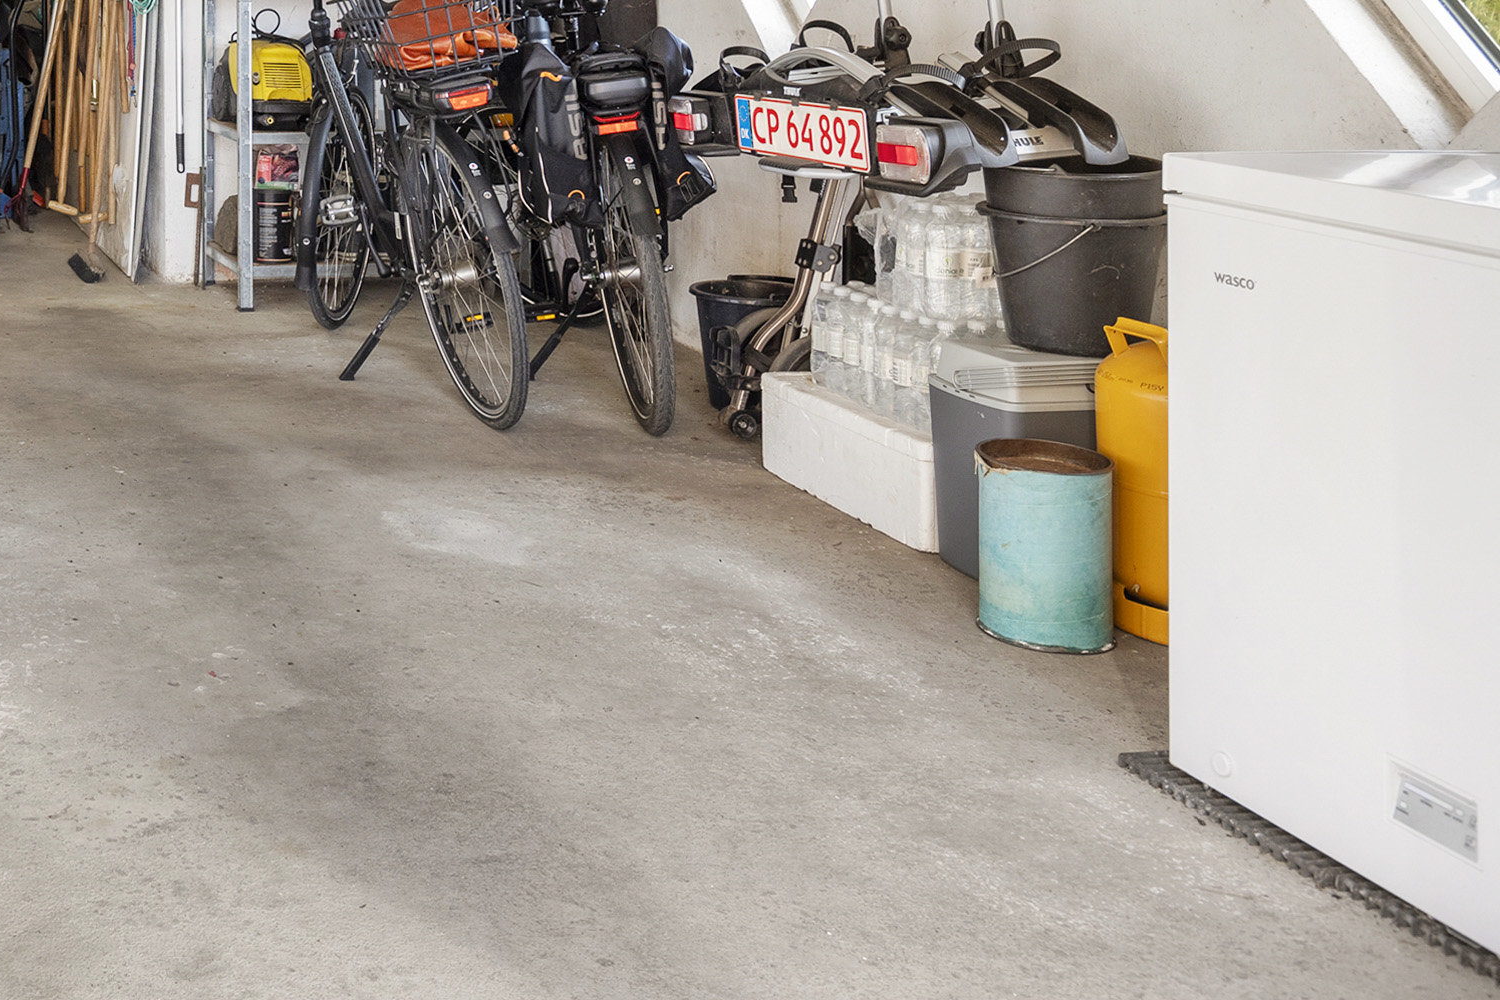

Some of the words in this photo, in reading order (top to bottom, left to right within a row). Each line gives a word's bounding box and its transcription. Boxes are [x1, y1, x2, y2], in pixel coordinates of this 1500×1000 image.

[740, 127, 750, 140] DK
[752, 106, 779, 145] CP
[1013, 135, 1044, 147] HULE
[1213, 271, 1255, 291] wasco
